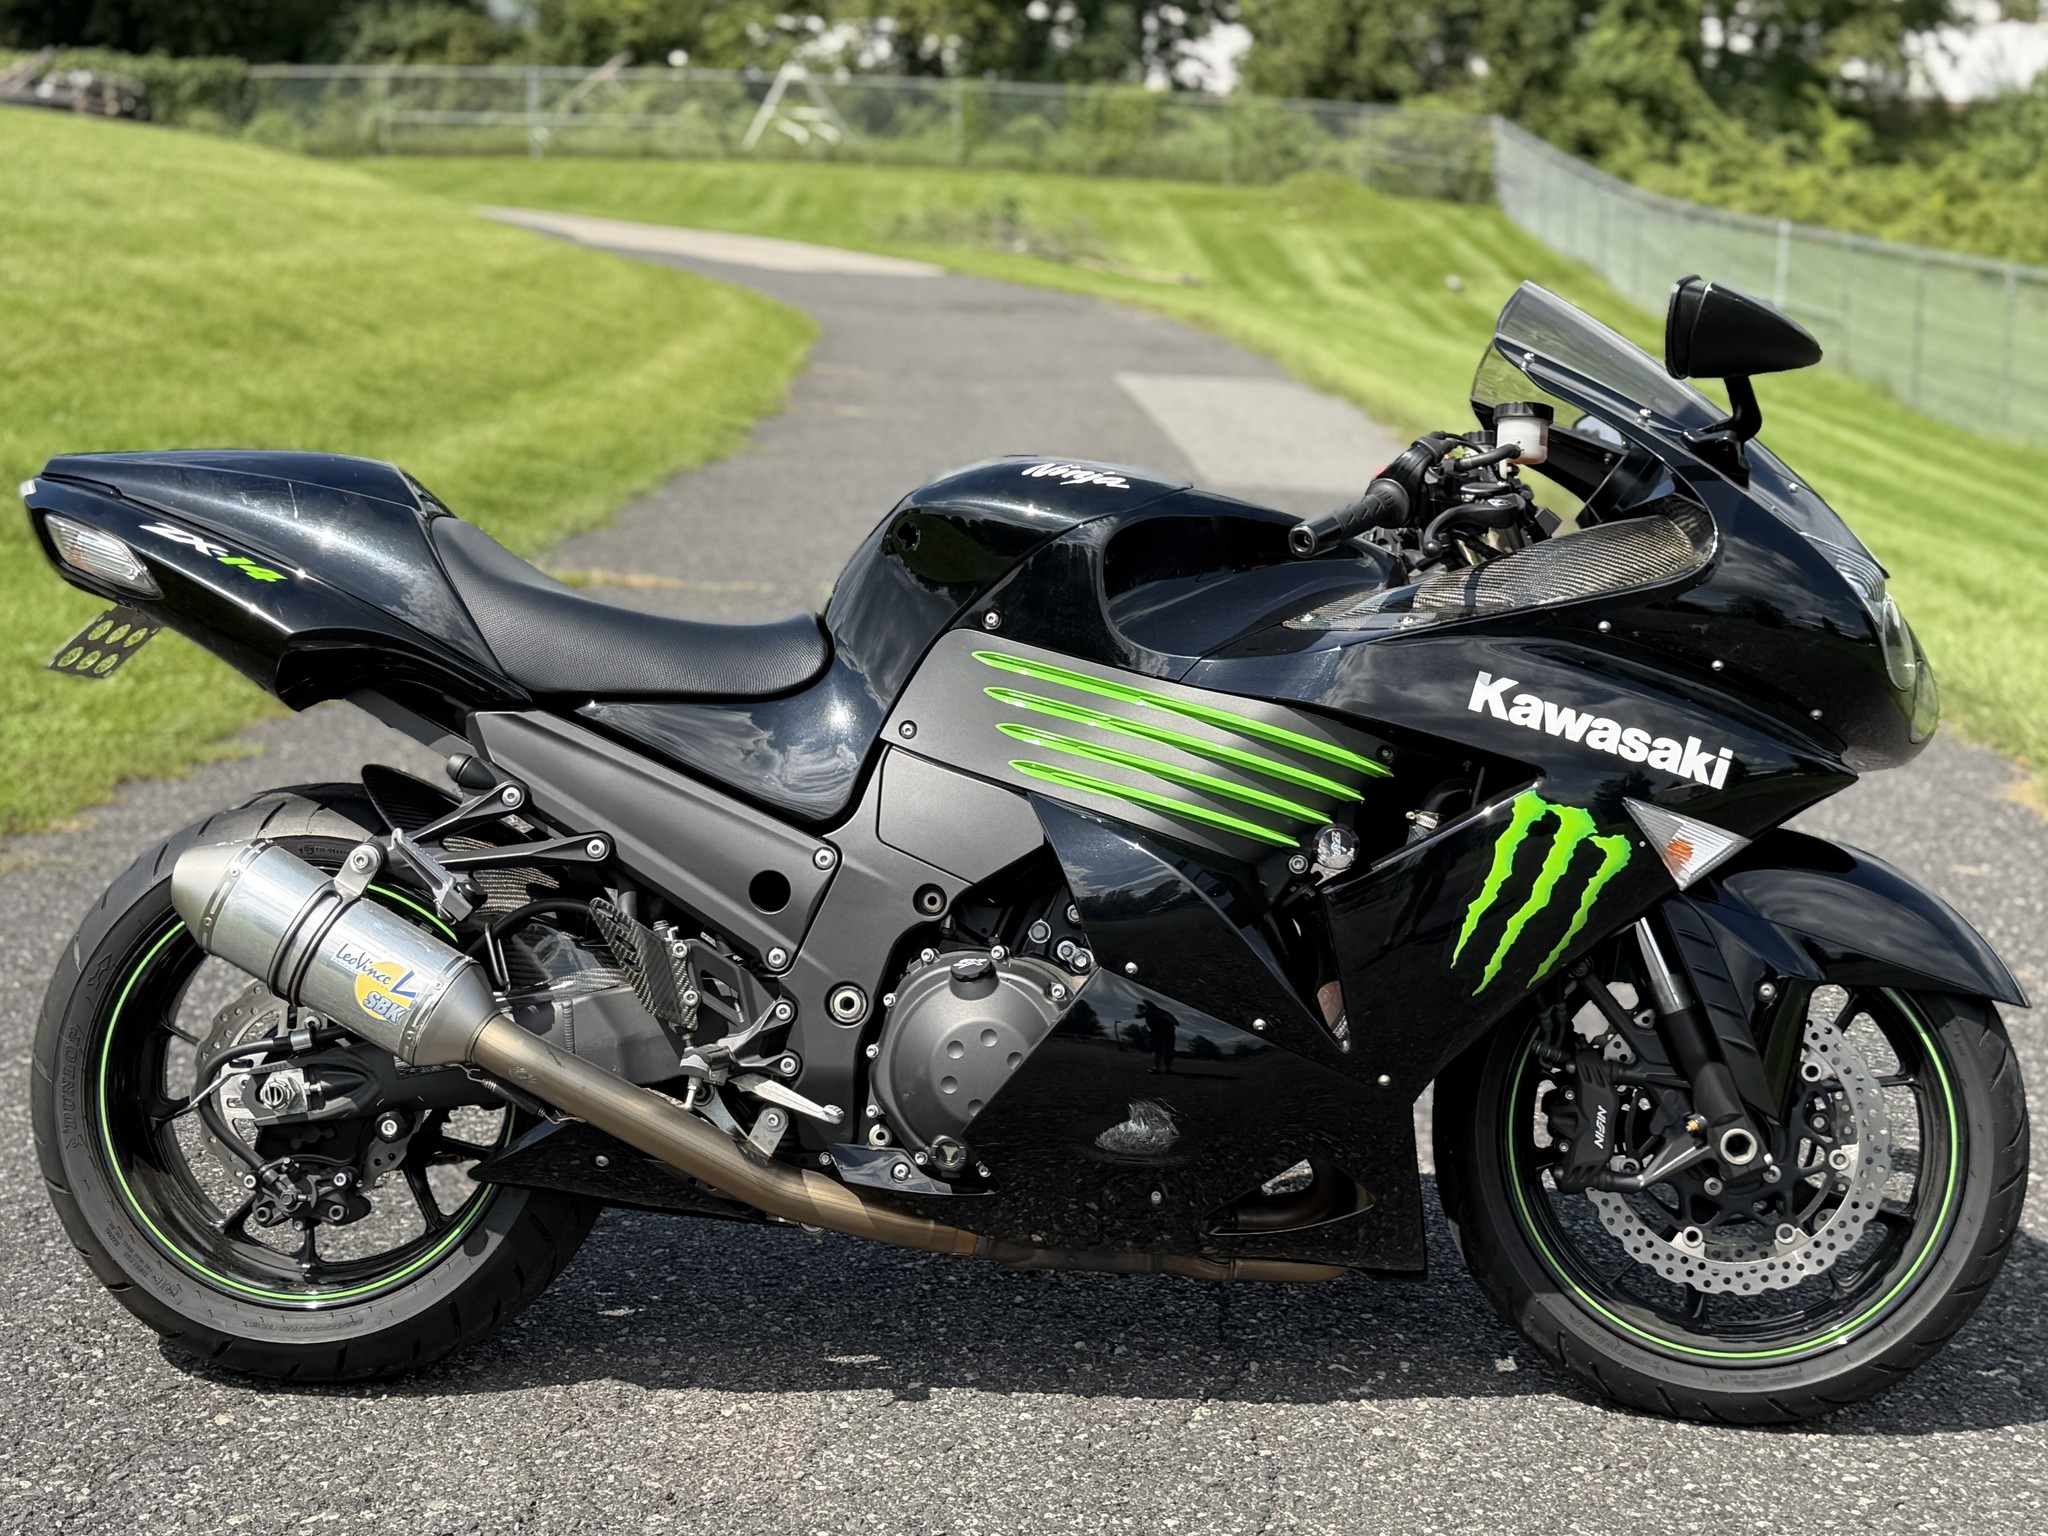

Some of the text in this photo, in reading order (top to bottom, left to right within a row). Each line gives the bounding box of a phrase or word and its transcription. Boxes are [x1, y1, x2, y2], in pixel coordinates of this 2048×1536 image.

[1021, 462, 1130, 489] Ninja
[138, 521, 288, 582] ZX-14
[1467, 670, 1734, 790] Kawasaki
[335, 943, 392, 985] LeoVince
[361, 990, 411, 1026] SBK
[61, 1024, 81, 1134] DUNLOP
